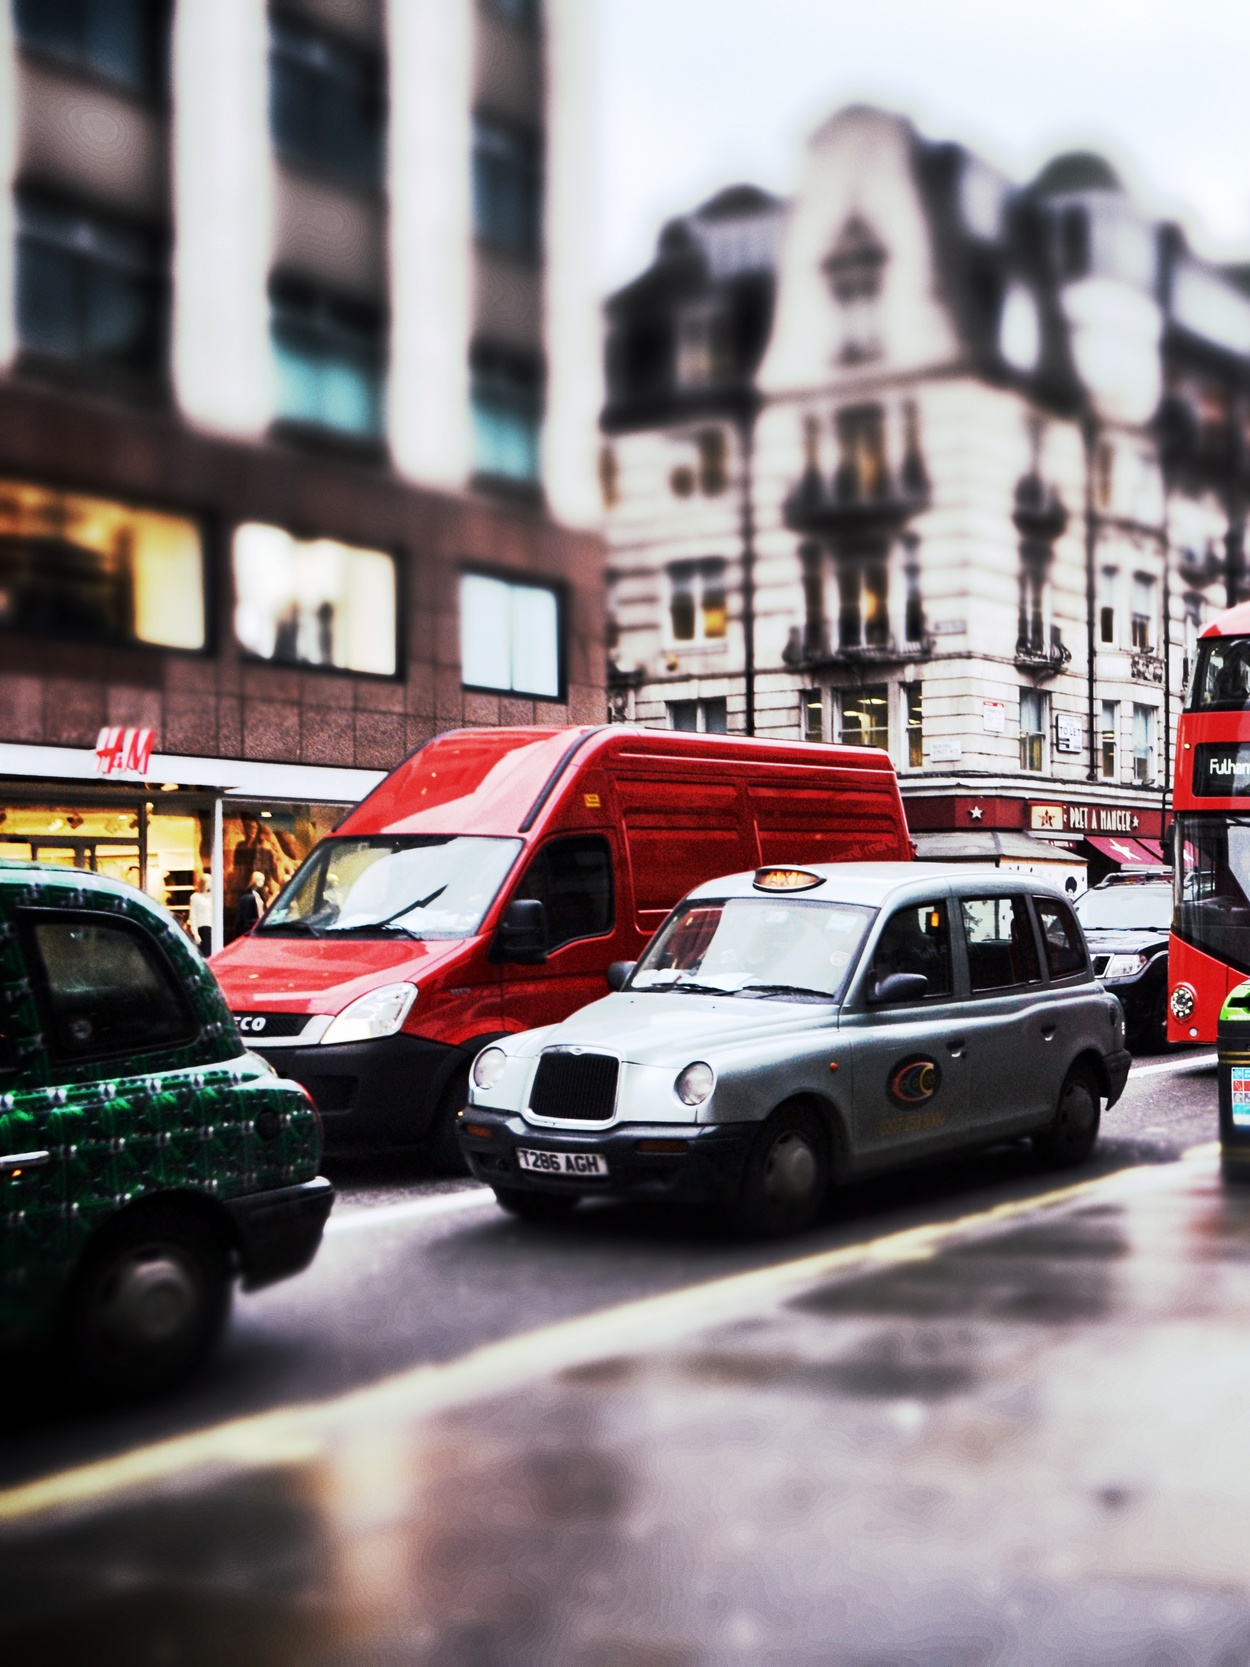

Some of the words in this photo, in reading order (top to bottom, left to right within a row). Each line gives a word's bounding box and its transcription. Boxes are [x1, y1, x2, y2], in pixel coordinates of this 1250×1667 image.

[95, 726, 156, 775] H&M
[1069, 806, 1089, 829] PRET
[1091, 808, 1098, 830] A
[1100, 809, 1132, 832] MANGER
[520, 1149, 561, 1171] T286
[564, 1154, 601, 1173] AGH
